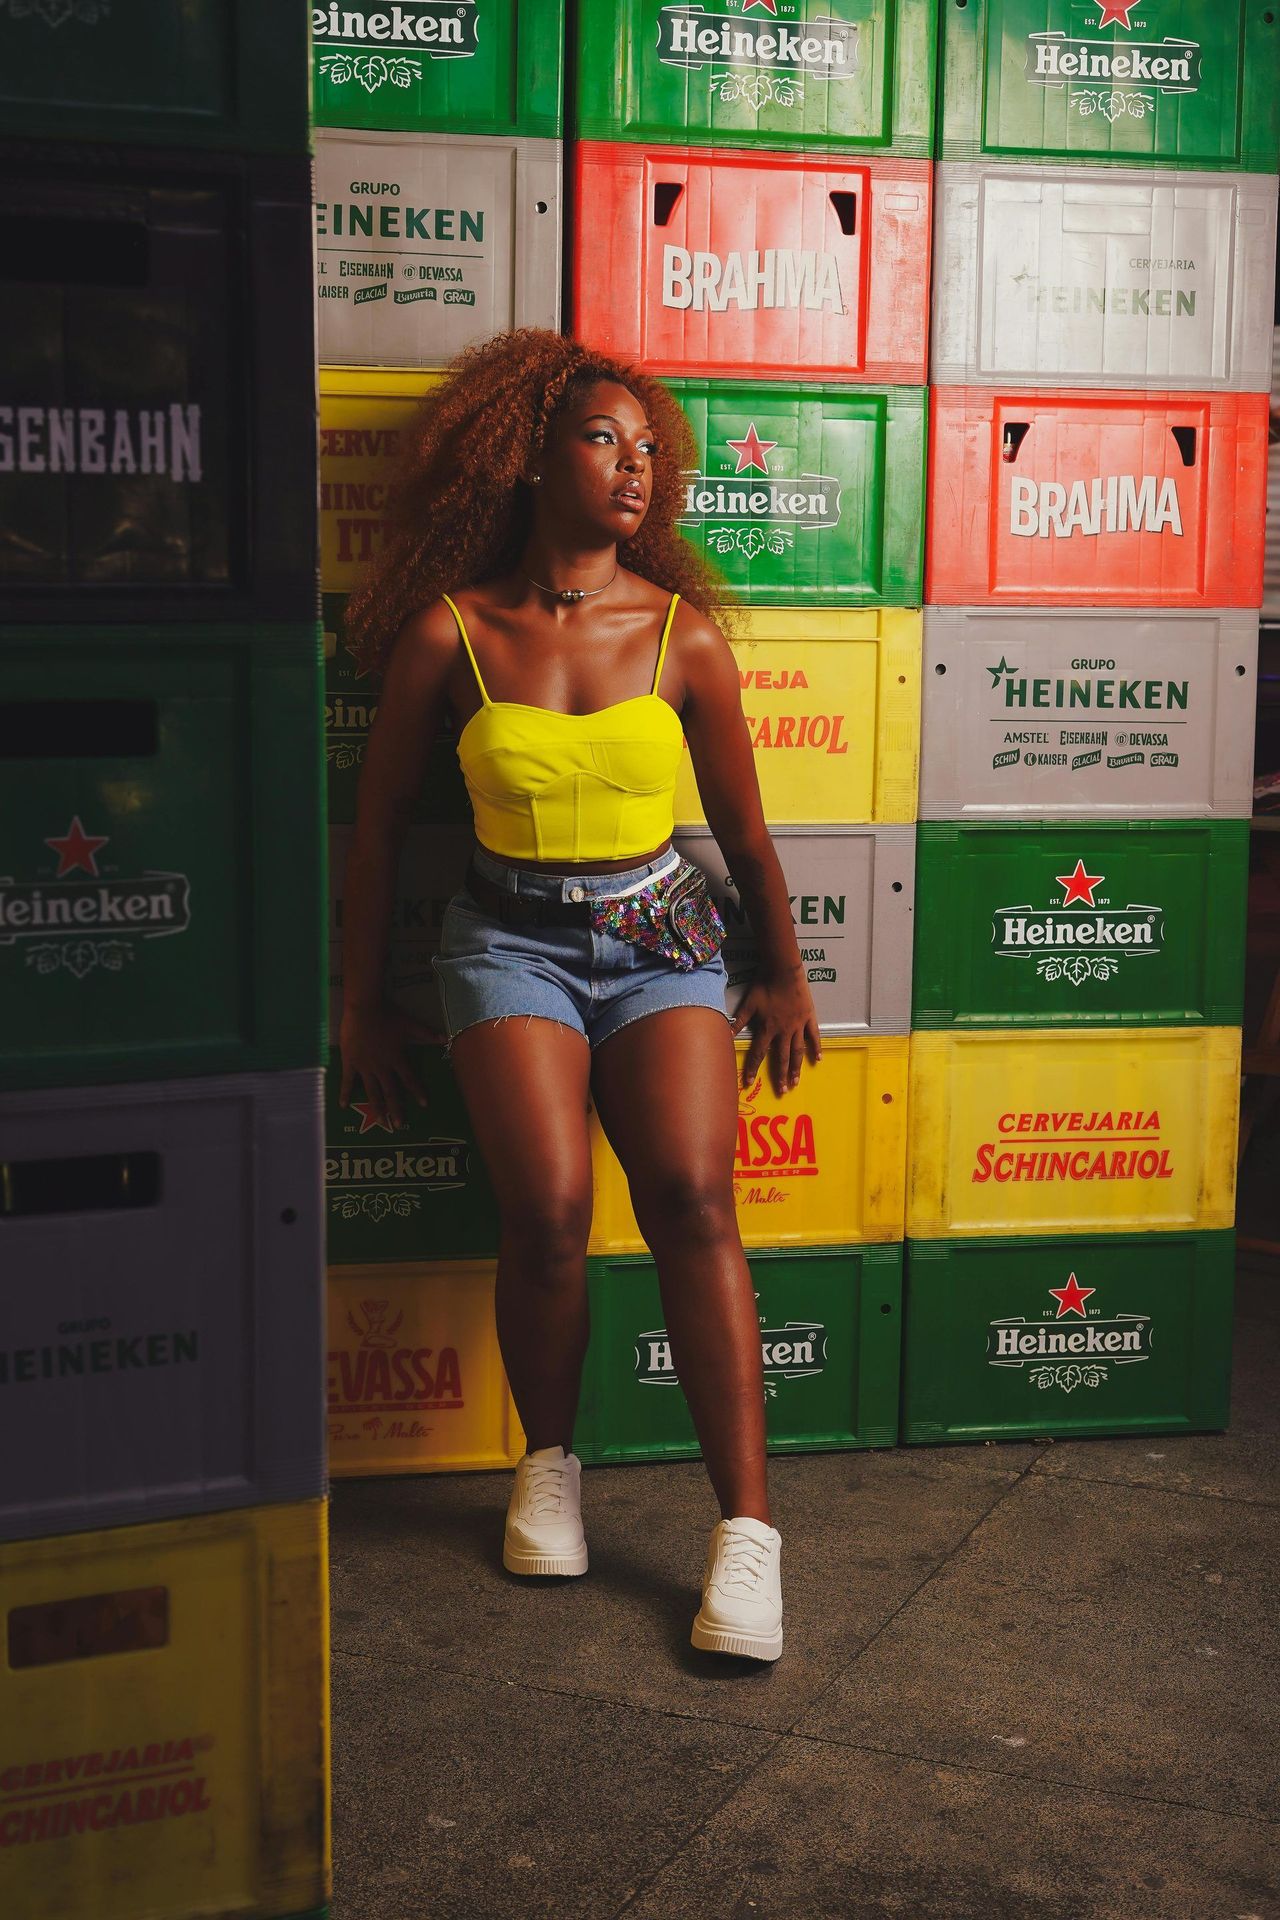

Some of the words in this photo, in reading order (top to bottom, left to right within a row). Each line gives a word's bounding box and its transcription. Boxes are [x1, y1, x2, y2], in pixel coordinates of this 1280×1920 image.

[312, 1, 465, 44] eineken
[1084, 18, 1097, 26] EST.
[1133, 20, 1147, 29] 1873
[669, 18, 848, 65] Heineken
[1035, 44, 1191, 82] Heineken
[349, 181, 401, 196] GRUPO
[339, 260, 394, 280] EISENBAHN
[419, 265, 464, 283] DEVASSA
[1128, 257, 1196, 271] CERVEJARIA
[661, 243, 846, 316] BRAHMA
[354, 285, 387, 304] GLACIAL
[1010, 474, 1184, 539] BRAHMA
[1070, 658, 1116, 671] GRUPO
[737, 670, 809, 690] VEJA
[1005, 678, 1190, 710] HEINEKEN
[1003, 731, 1050, 744] AMSTEL
[1059, 730, 1108, 746] EISENBAHN
[1129, 732, 1169, 747] DEVASSA
[993, 752, 1019, 768] SCHIN
[1037, 752, 1068, 766] KAISER
[1072, 752, 1101, 769] GLACIAL
[1108, 753, 1144, 768] Bavaria
[1150, 752, 1177, 767] GRAU
[1097, 897, 1111, 905] 1873
[1002, 917, 1154, 945] Heineken
[807, 967, 836, 982] GRAU
[997, 1110, 1161, 1134] CERVEJARIA
[734, 1113, 817, 1167] ASSA
[971, 1143, 1175, 1183] SCHINCARIOL
[996, 1326, 1143, 1355] Heineken
